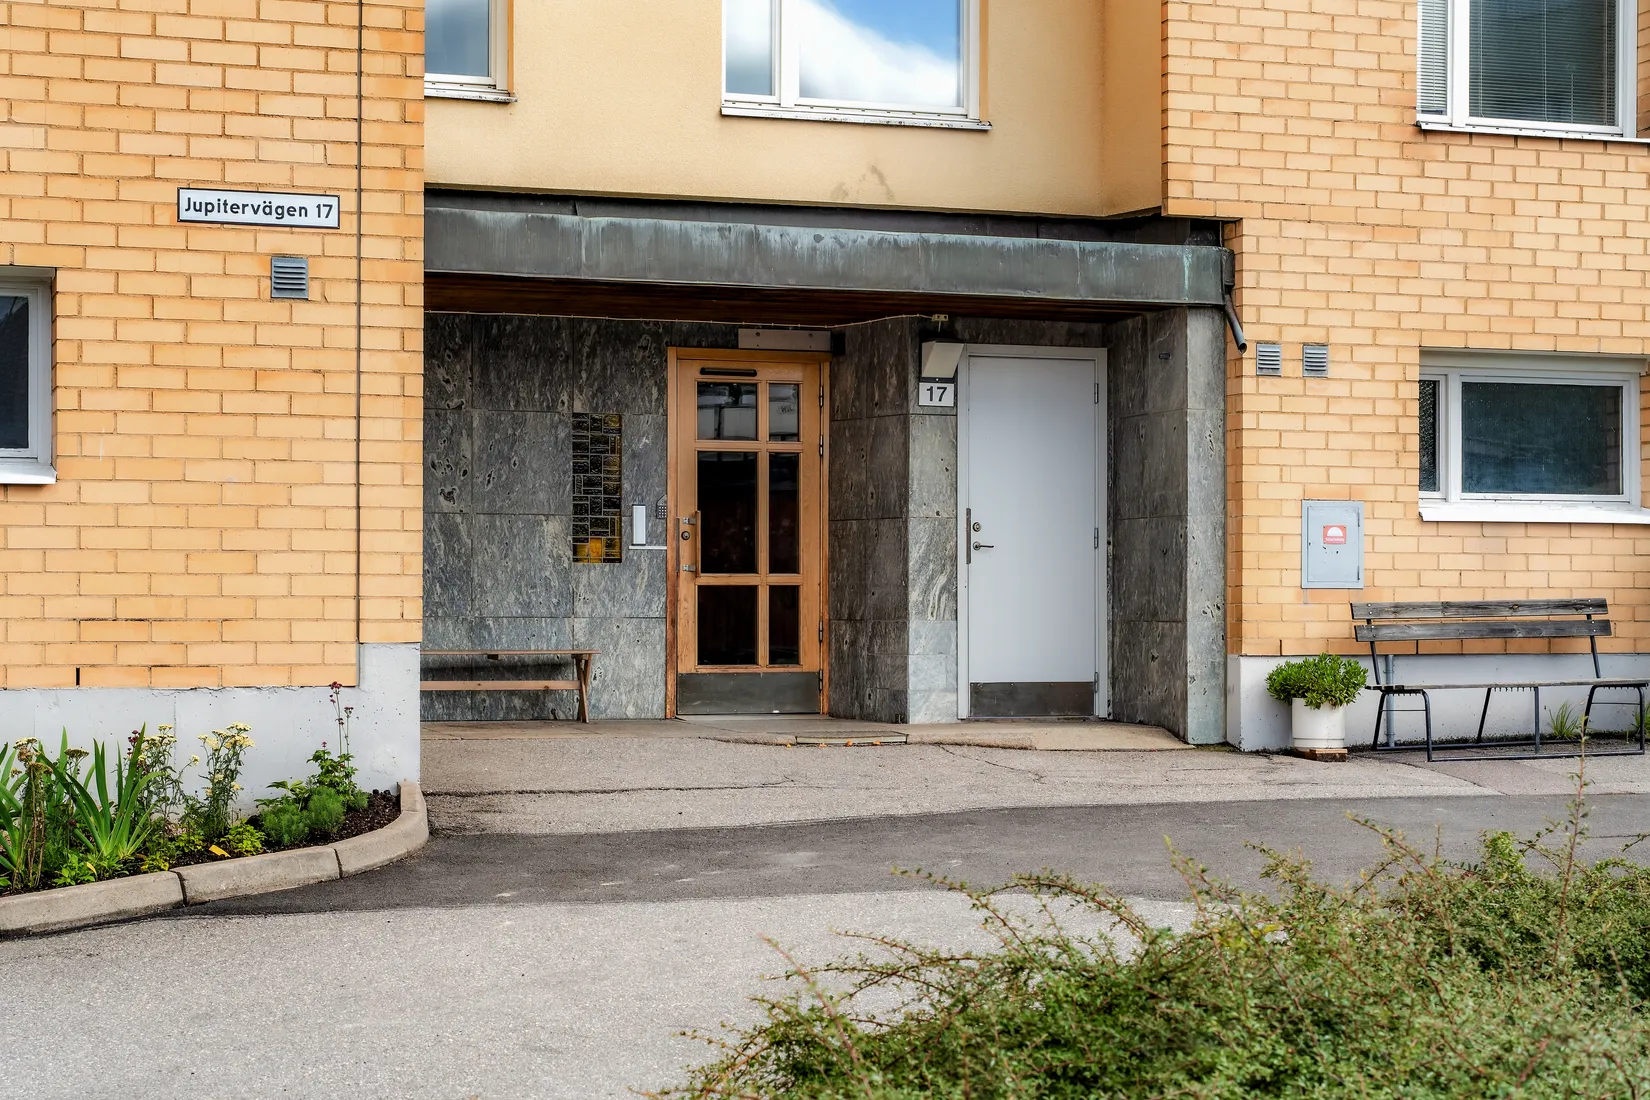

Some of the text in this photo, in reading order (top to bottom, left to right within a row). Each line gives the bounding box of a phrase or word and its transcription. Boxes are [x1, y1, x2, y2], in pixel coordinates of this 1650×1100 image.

[184, 197, 333, 220] Jupitervägen 17
[926, 385, 948, 402] 17
